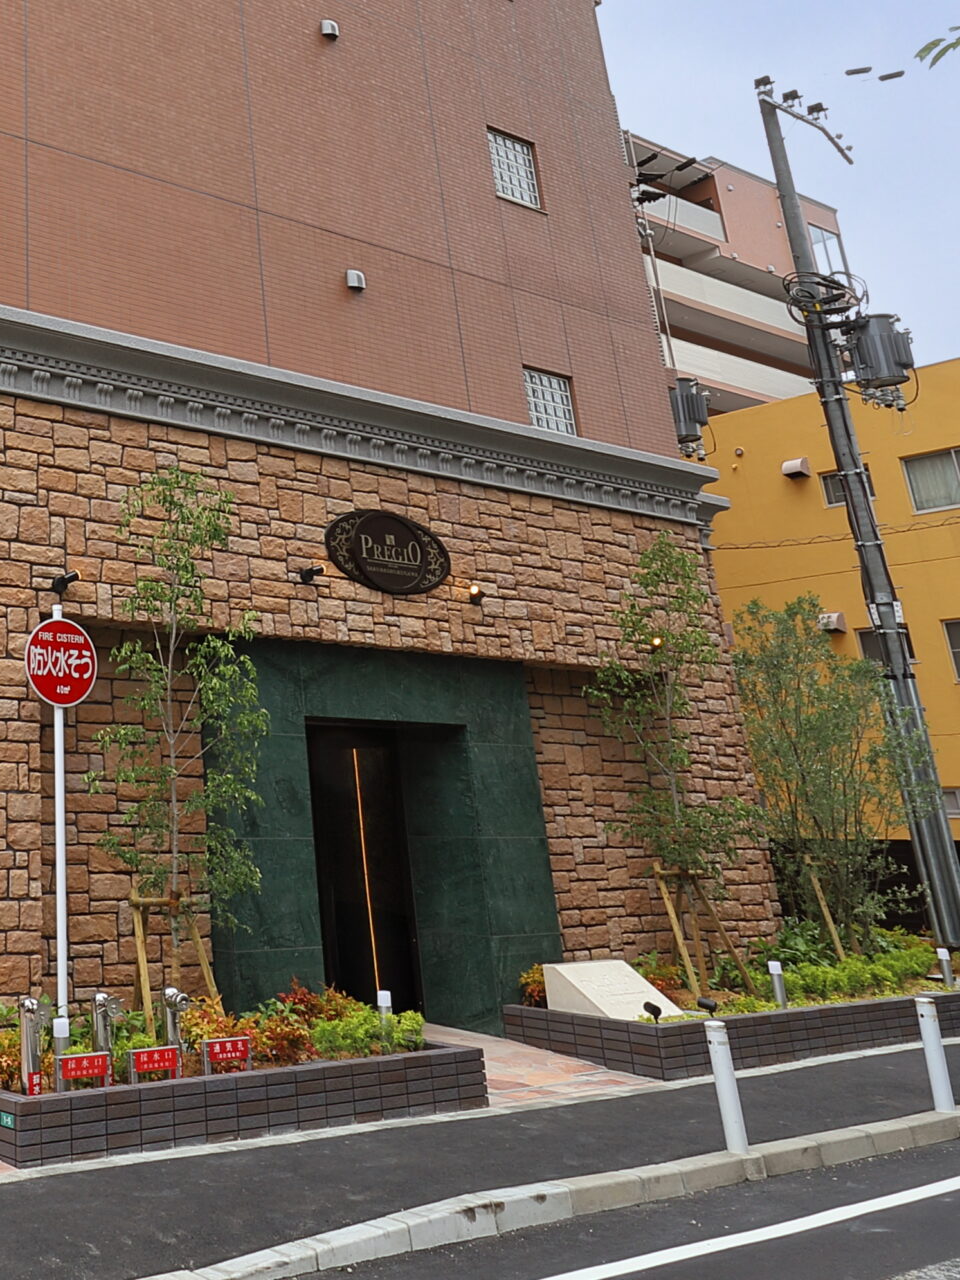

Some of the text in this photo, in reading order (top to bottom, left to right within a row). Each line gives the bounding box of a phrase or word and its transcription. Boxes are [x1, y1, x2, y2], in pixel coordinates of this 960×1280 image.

[38, 631, 85, 644] FIRE CISTERN
[30, 645, 93, 680] 防火水そう
